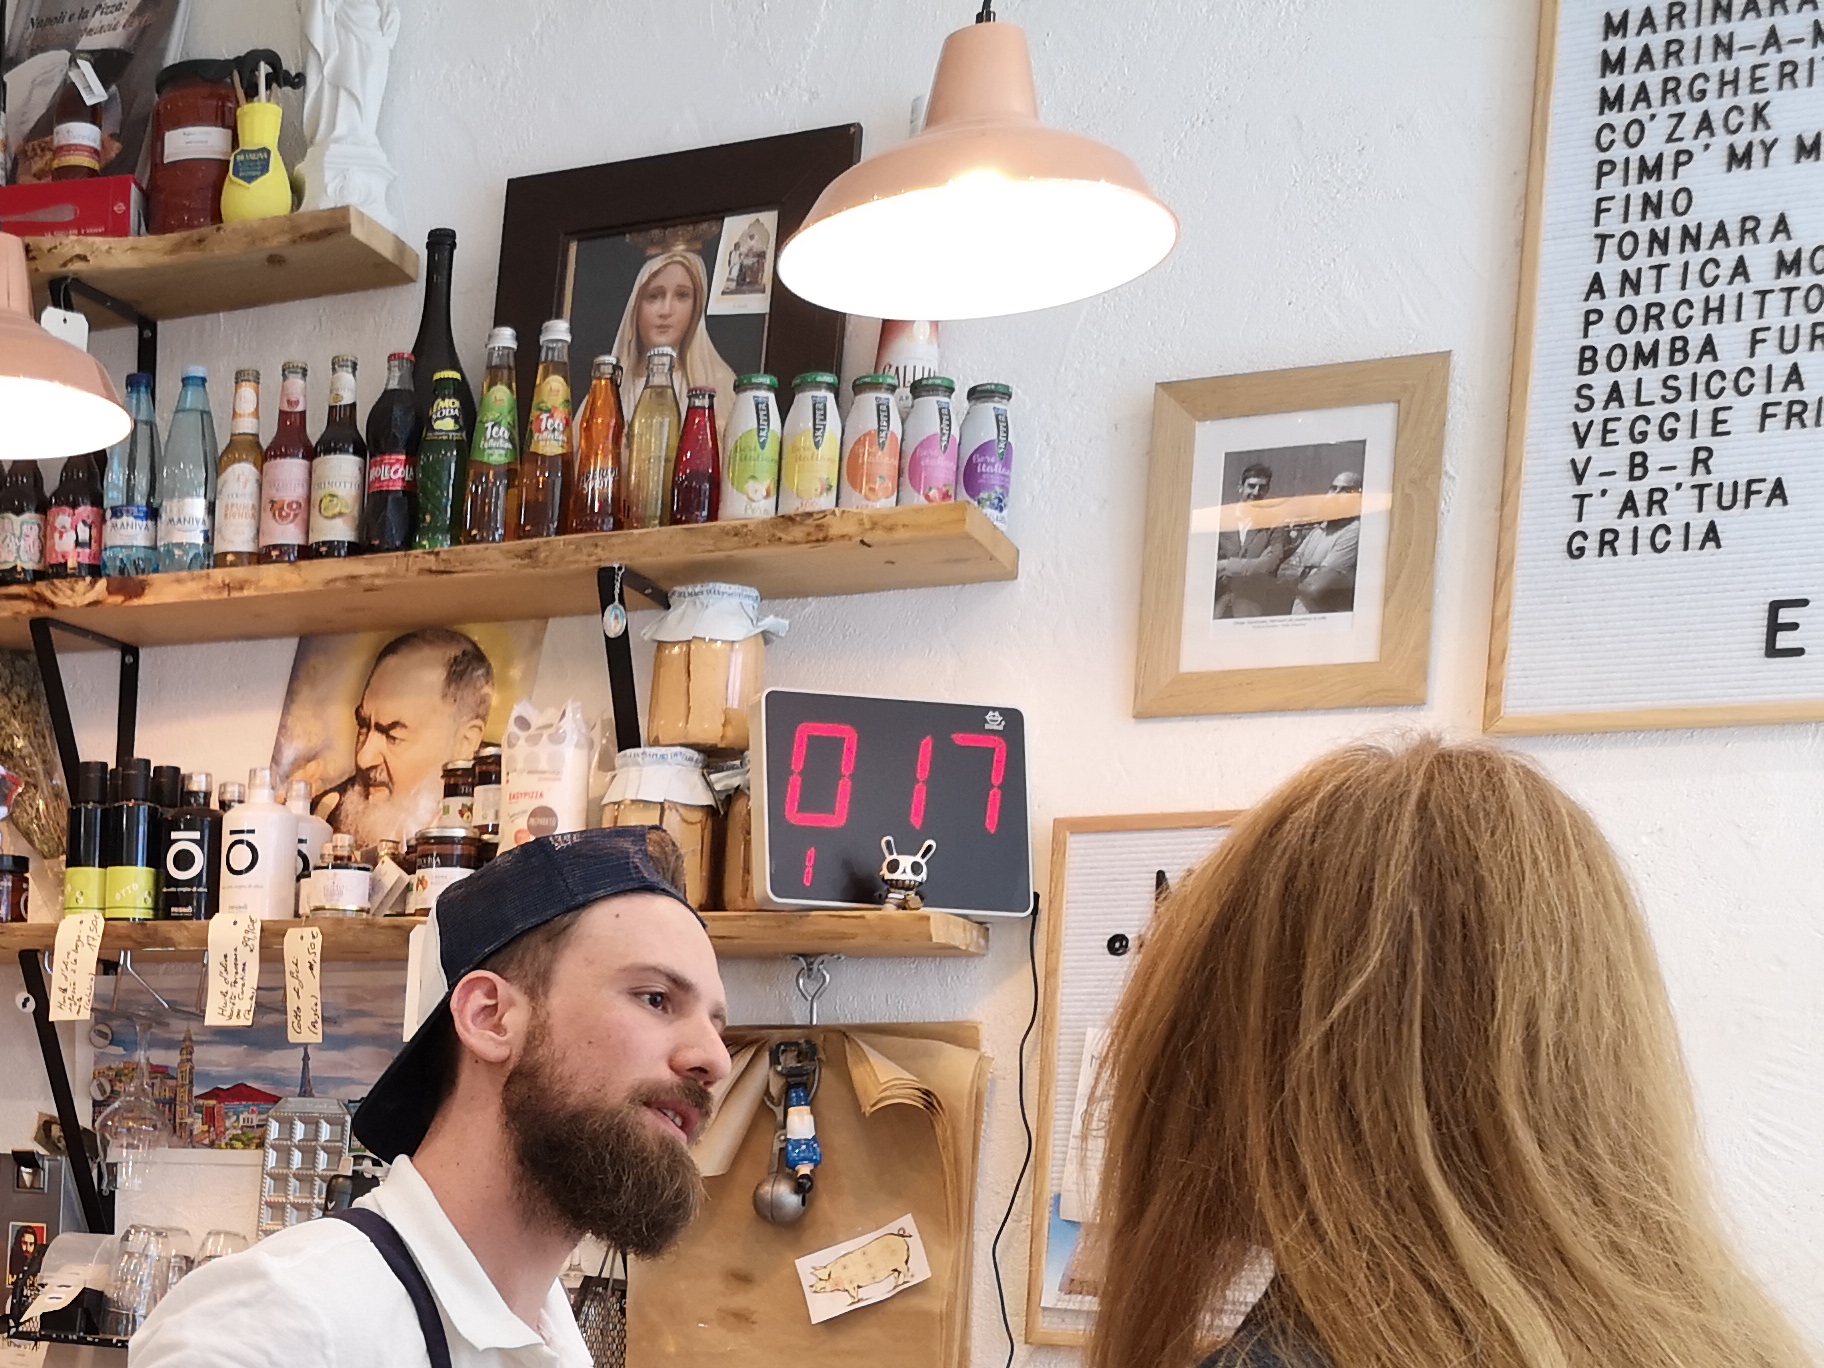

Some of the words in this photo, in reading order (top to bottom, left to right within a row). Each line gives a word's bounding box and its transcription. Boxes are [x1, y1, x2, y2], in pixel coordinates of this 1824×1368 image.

[1598, 56, 1824, 115] MARGHERI
[1595, 101, 1770, 152] CO'ZACK
[1726, 138, 1778, 173] MY
[1594, 187, 1693, 227] FINO
[1594, 212, 1792, 263] TONNARA
[1583, 254, 1751, 302] ANTICA
[1578, 333, 1718, 376] BOMBA
[1574, 361, 1804, 412] SALSICCIA
[484, 421, 510, 439] Tea
[539, 412, 565, 432] Tea
[1572, 406, 1733, 449] VEGGIE
[1570, 446, 1714, 486] V-B-R
[1572, 476, 1788, 523] T'AR'TUFA
[110, 521, 150, 532] MANIVA
[165, 515, 208, 527] MANIVA
[1566, 519, 1722, 560] GRICIA
[1764, 597, 1811, 658] E
[784, 722, 1007, 834] 017
[803, 847, 816, 887] 1
[115, 882, 139, 901] OTTO
